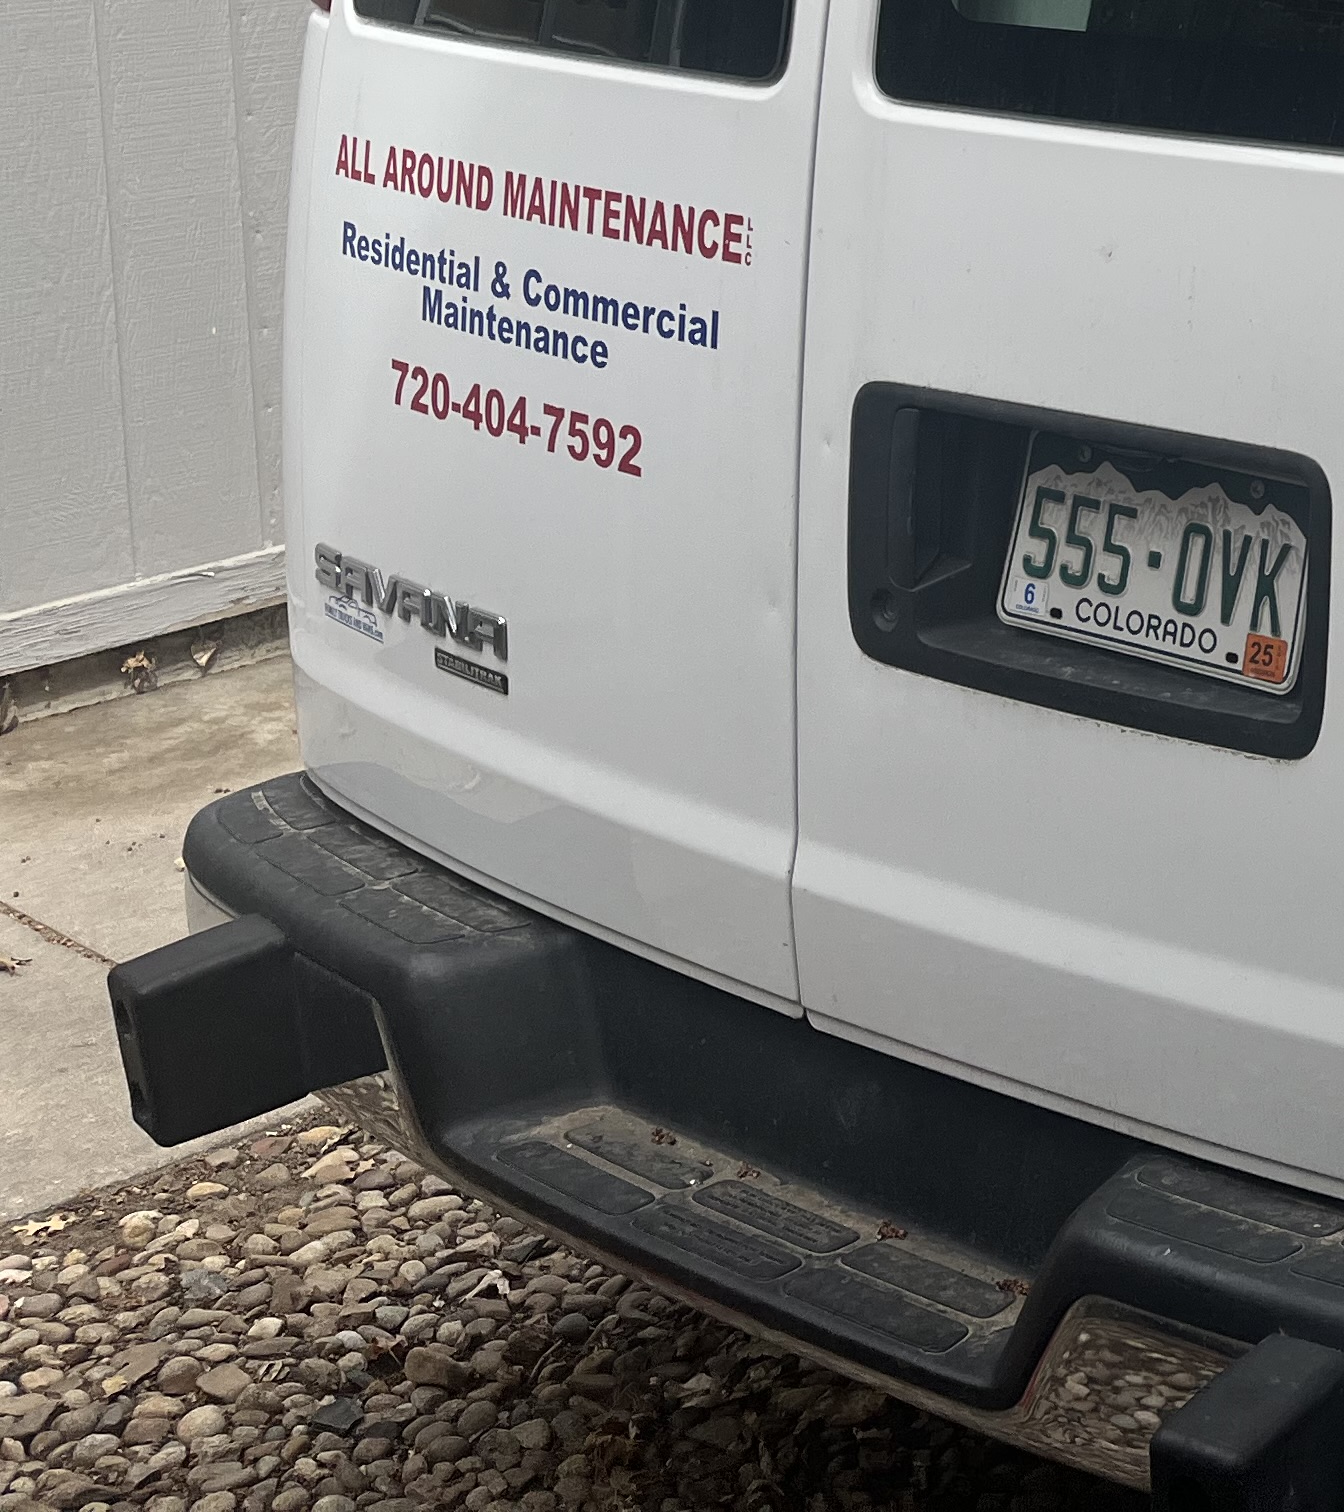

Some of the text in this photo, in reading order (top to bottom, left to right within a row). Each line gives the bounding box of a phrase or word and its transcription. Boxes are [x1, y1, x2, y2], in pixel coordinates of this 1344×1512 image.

[335, 134, 744, 266] ALL AROUND MAINTENANCE
[744, 216, 754, 267] LLC
[342, 221, 720, 350] Residential & Commercial
[422, 286, 609, 370] Maintenance
[391, 358, 643, 477] 720-404-7592
[314, 542, 508, 662] SAVANA
[1024, 582, 1036, 605] 6
[1075, 597, 1218, 654] COLORADO
[1249, 641, 1274, 667] 25
